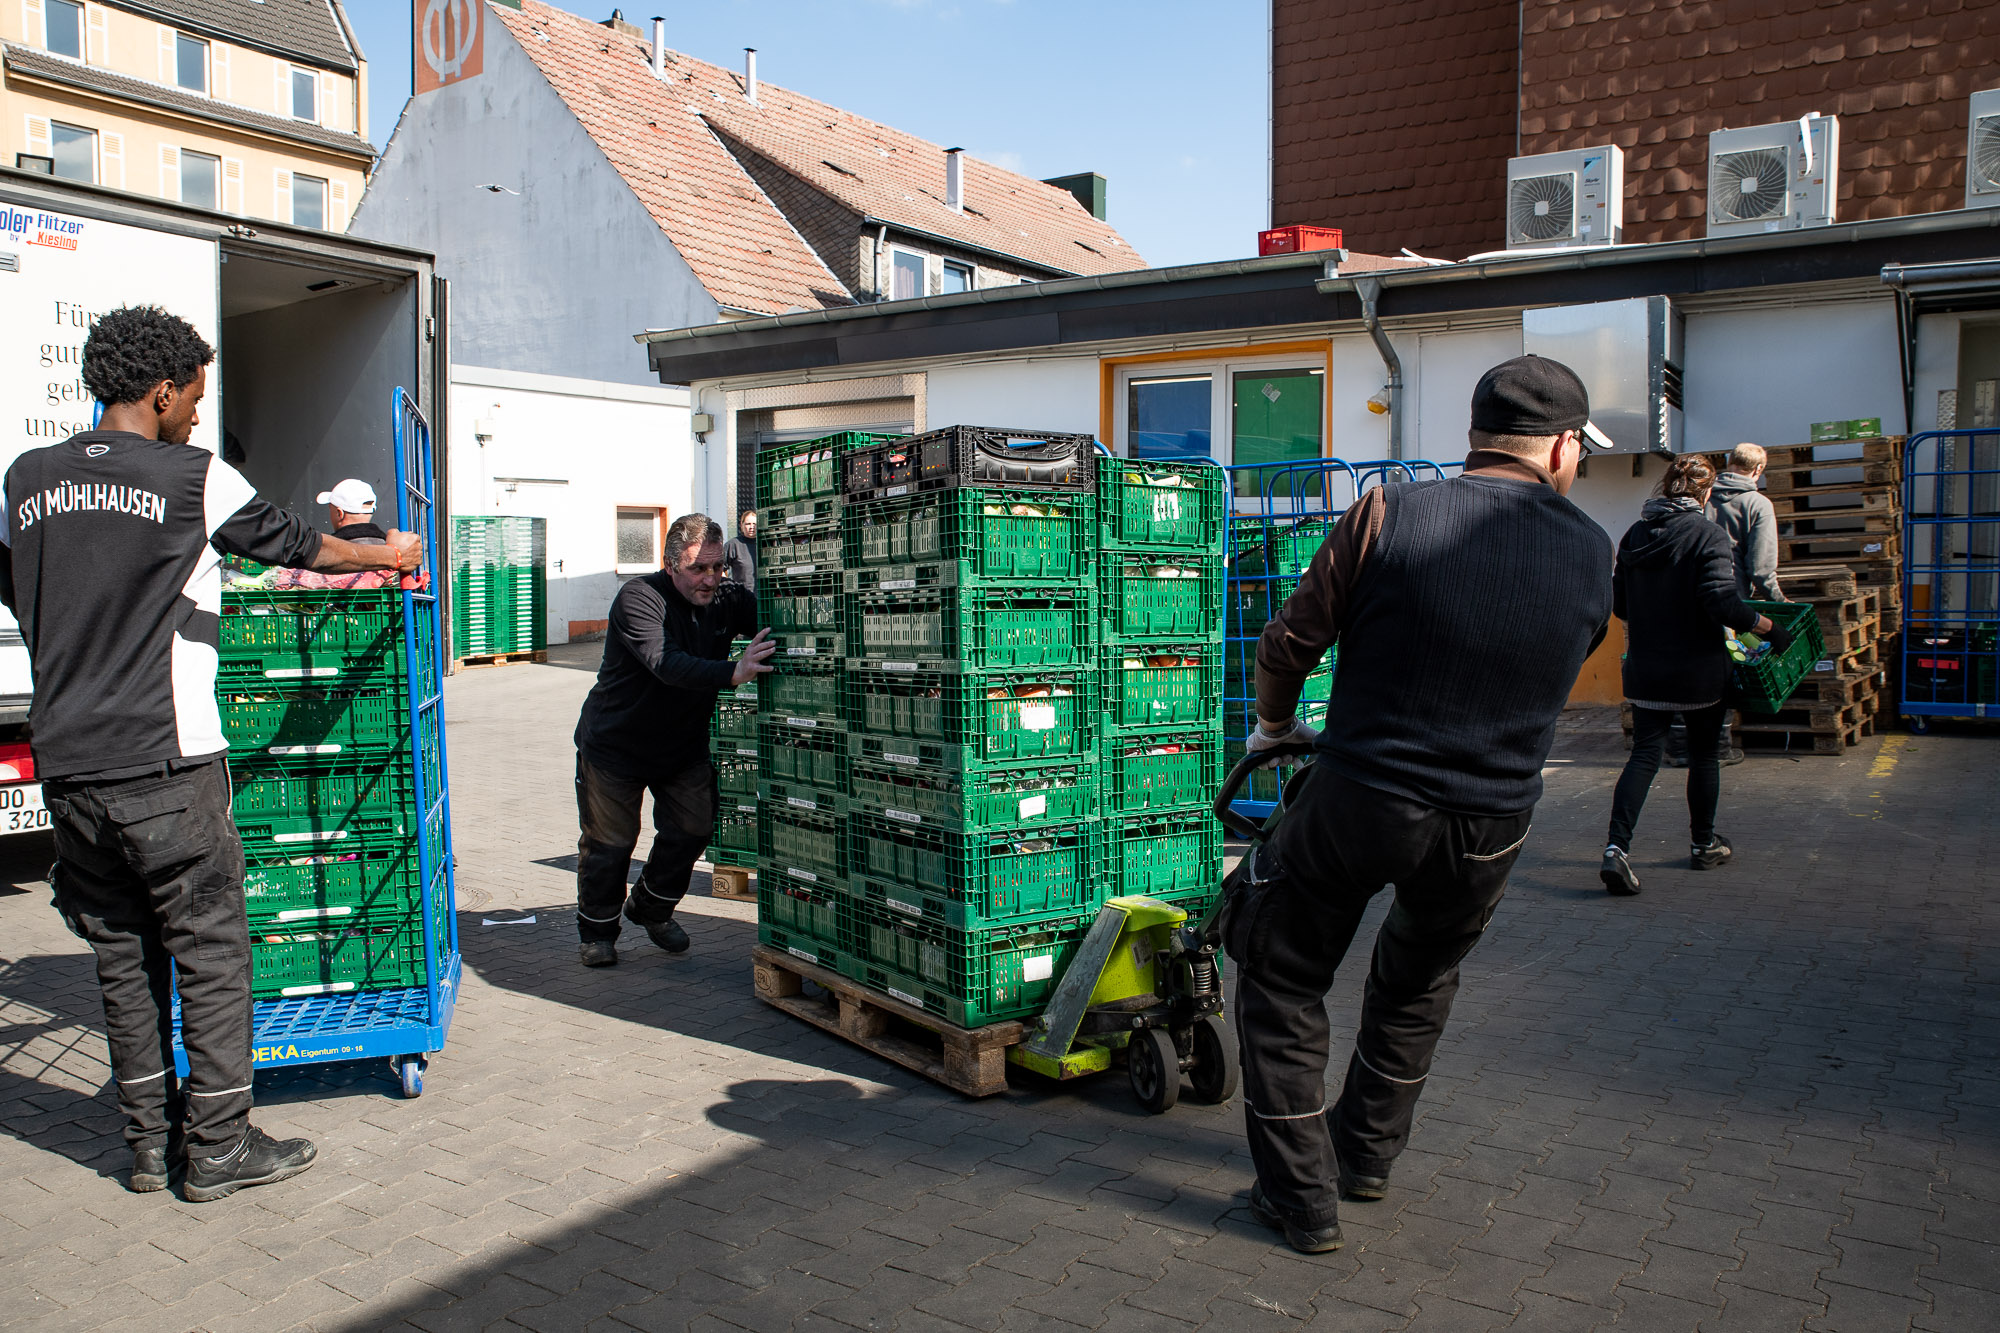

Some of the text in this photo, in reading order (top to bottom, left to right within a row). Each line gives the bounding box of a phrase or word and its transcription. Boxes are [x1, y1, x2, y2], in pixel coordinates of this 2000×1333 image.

[37, 214, 84, 234] Flitzer
[10, 232, 78, 249] by Kiesling
[40, 343, 84, 367] gut
[46, 378, 96, 406] geb
[18, 480, 166, 531] SSV MÜHLHAUSEN
[9, 809, 48, 830] 320
[301, 1048, 338, 1058] Eigentum
